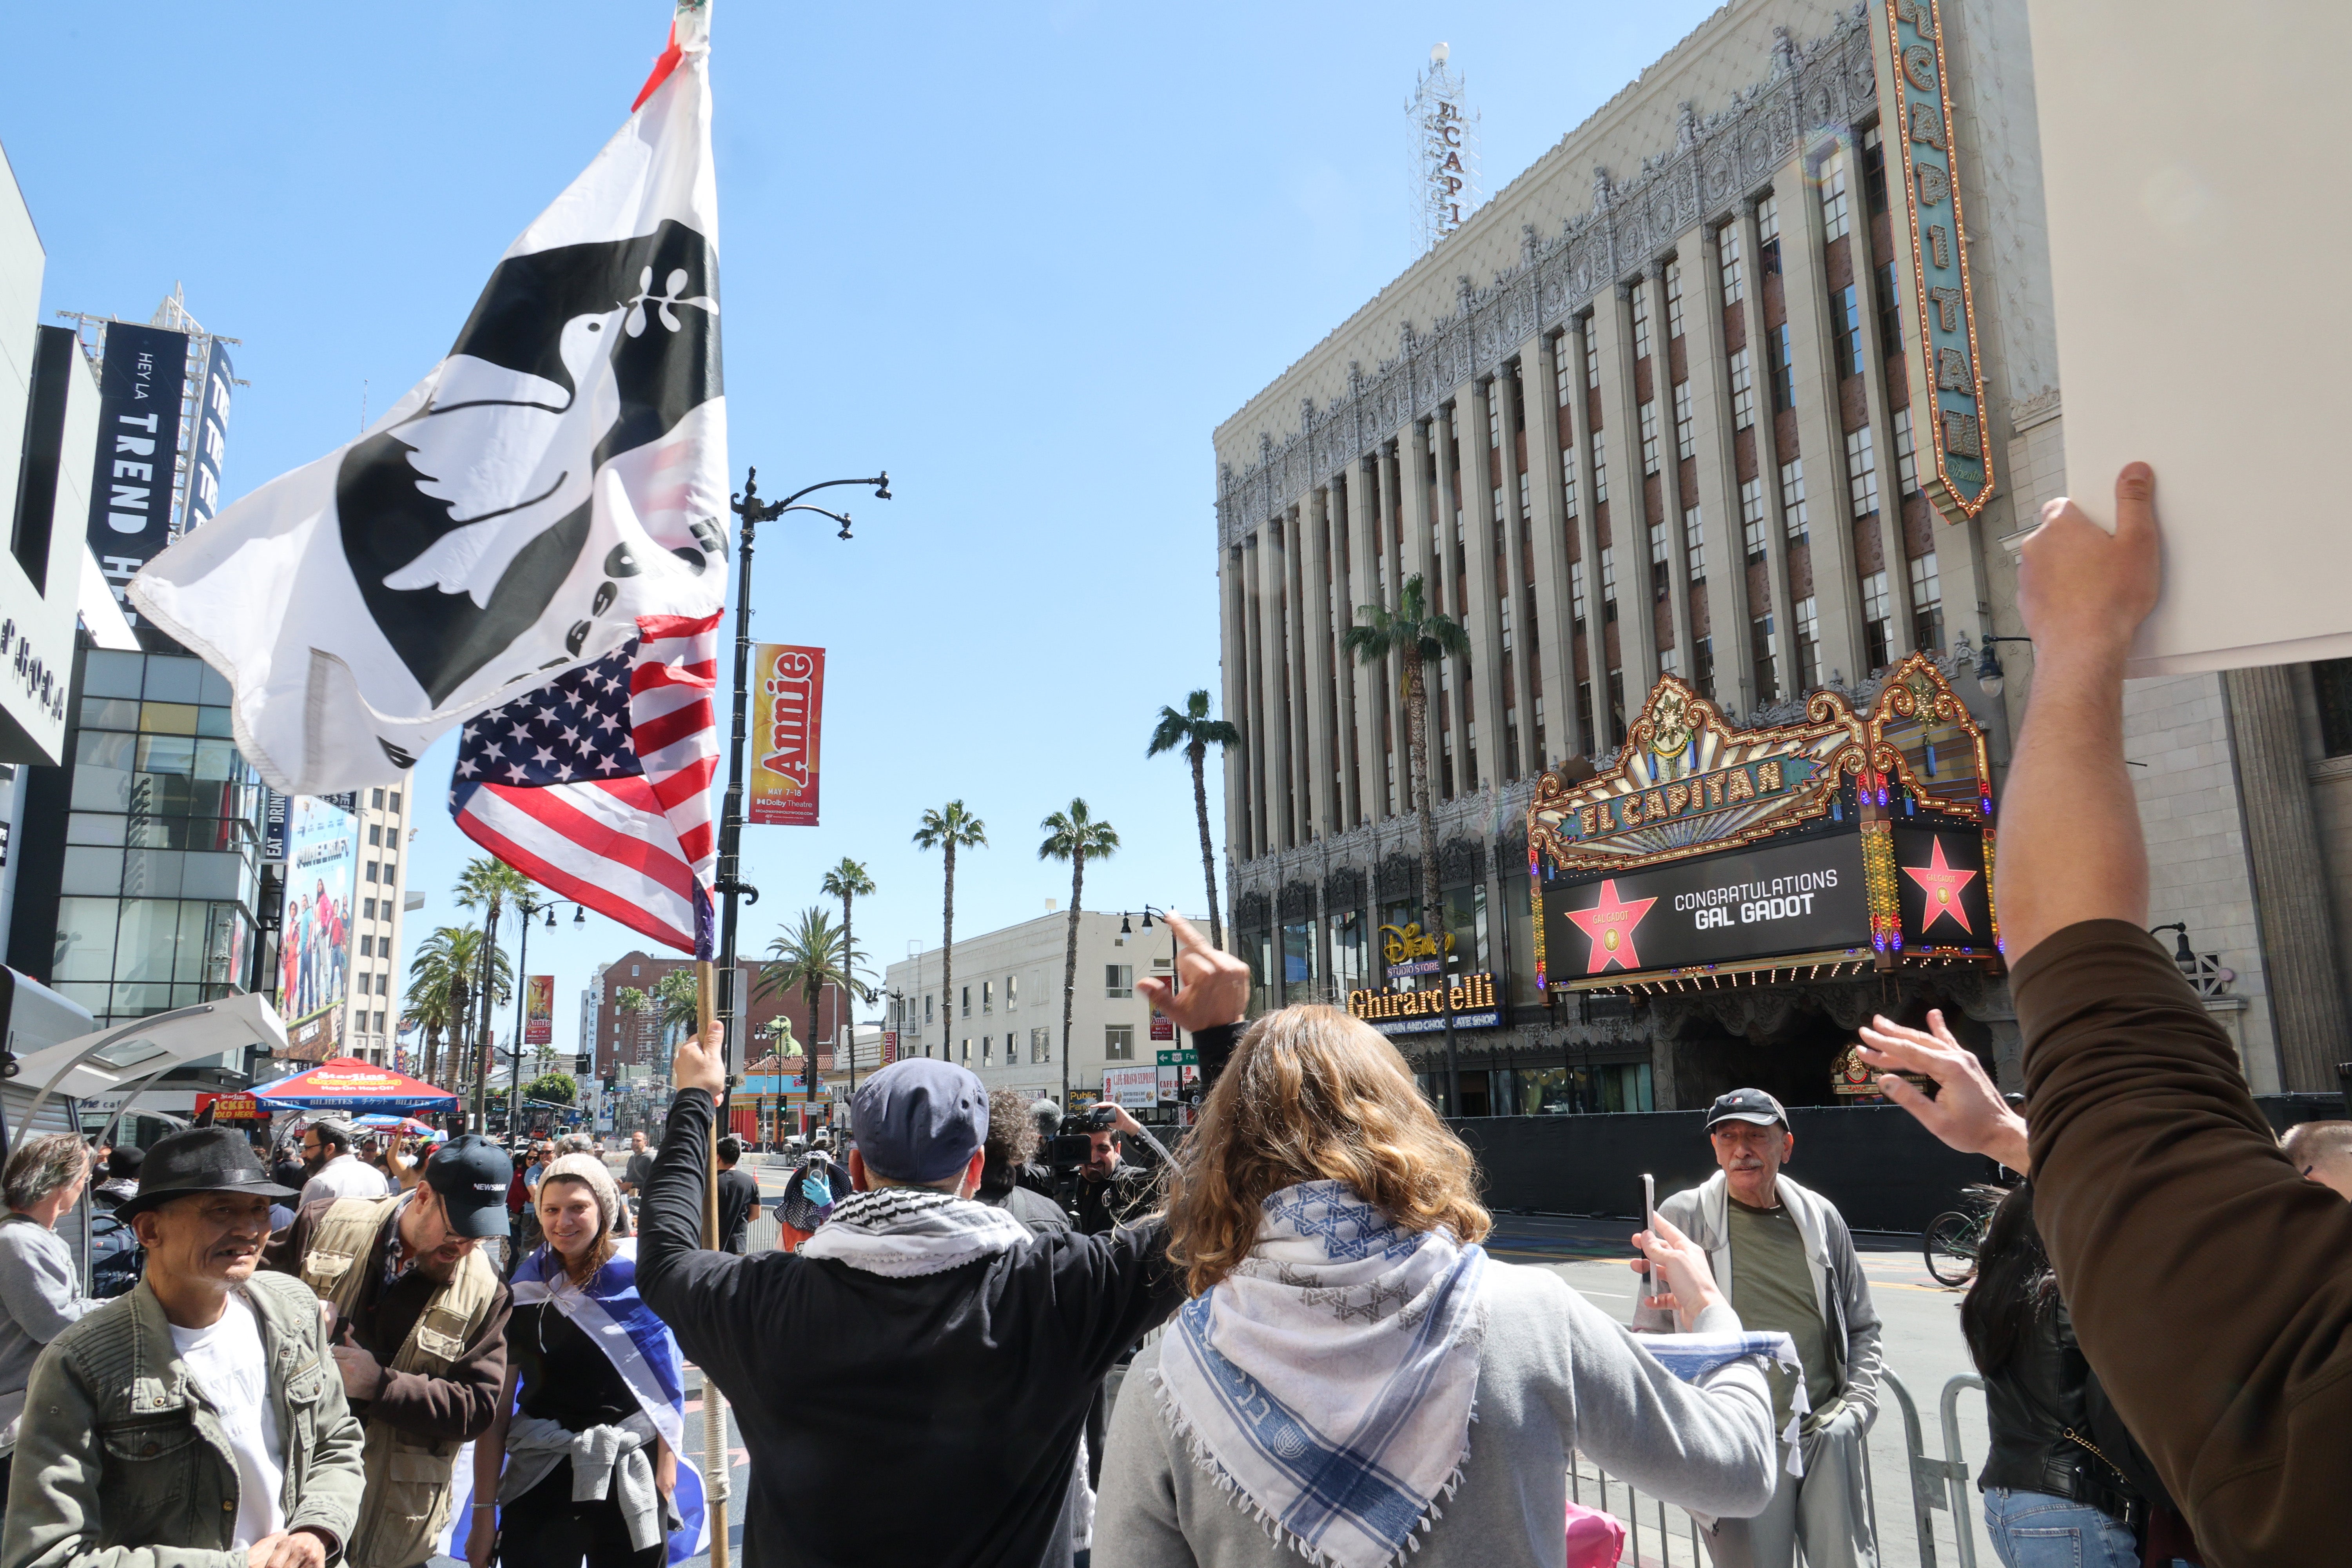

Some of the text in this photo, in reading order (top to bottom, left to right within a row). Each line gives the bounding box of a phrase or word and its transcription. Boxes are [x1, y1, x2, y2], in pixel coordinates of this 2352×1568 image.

[1903, 44, 1980, 458] CAPITAN
[134, 352, 153, 399] HEY LA
[108, 414, 158, 534] TREND
[1946, 459, 1986, 484] Theatre
[760, 652, 813, 788] Annie
[766, 799, 786, 808] Dolby
[1580, 804, 1616, 836] EL
[1622, 760, 1782, 827] CAPITAN
[266, 837, 283, 857] EAT
[297, 836, 350, 869] MINECRAFT
[316, 866, 334, 874] MOVIE
[1938, 875, 1956, 883] GADOT
[1675, 869, 1838, 911] CONGRATULATIONS
[1593, 910, 1628, 925] GAL GADOT
[1695, 893, 1814, 930] GAL GADOT
[1388, 961, 1440, 977] STUDIO STORE
[1348, 972, 1495, 1019] Ghirardelli
[526, 1019, 552, 1028] Annie
[1406, 1021, 1423, 1032] AND
[1423, 1016, 1473, 1031] CHOCLATE
[1472, 1014, 1497, 1027] SHOP
[299, 1025, 315, 1043] APRIL
[882, 1034, 894, 1064] Annie
[396, 1049, 407, 1070] WAX
[317, 1071, 389, 1081] Starline
[1114, 1072, 1122, 1085] CAFÉ
[1123, 1073, 1137, 1085] BRAVO
[1138, 1072, 1155, 1084] EXPRESS
[1160, 1079, 1172, 1088] CAFÉ
[458, 1085, 467, 1094] M
[1070, 1092, 1097, 1100] Public
[209, 1100, 256, 1111] ICKETS
